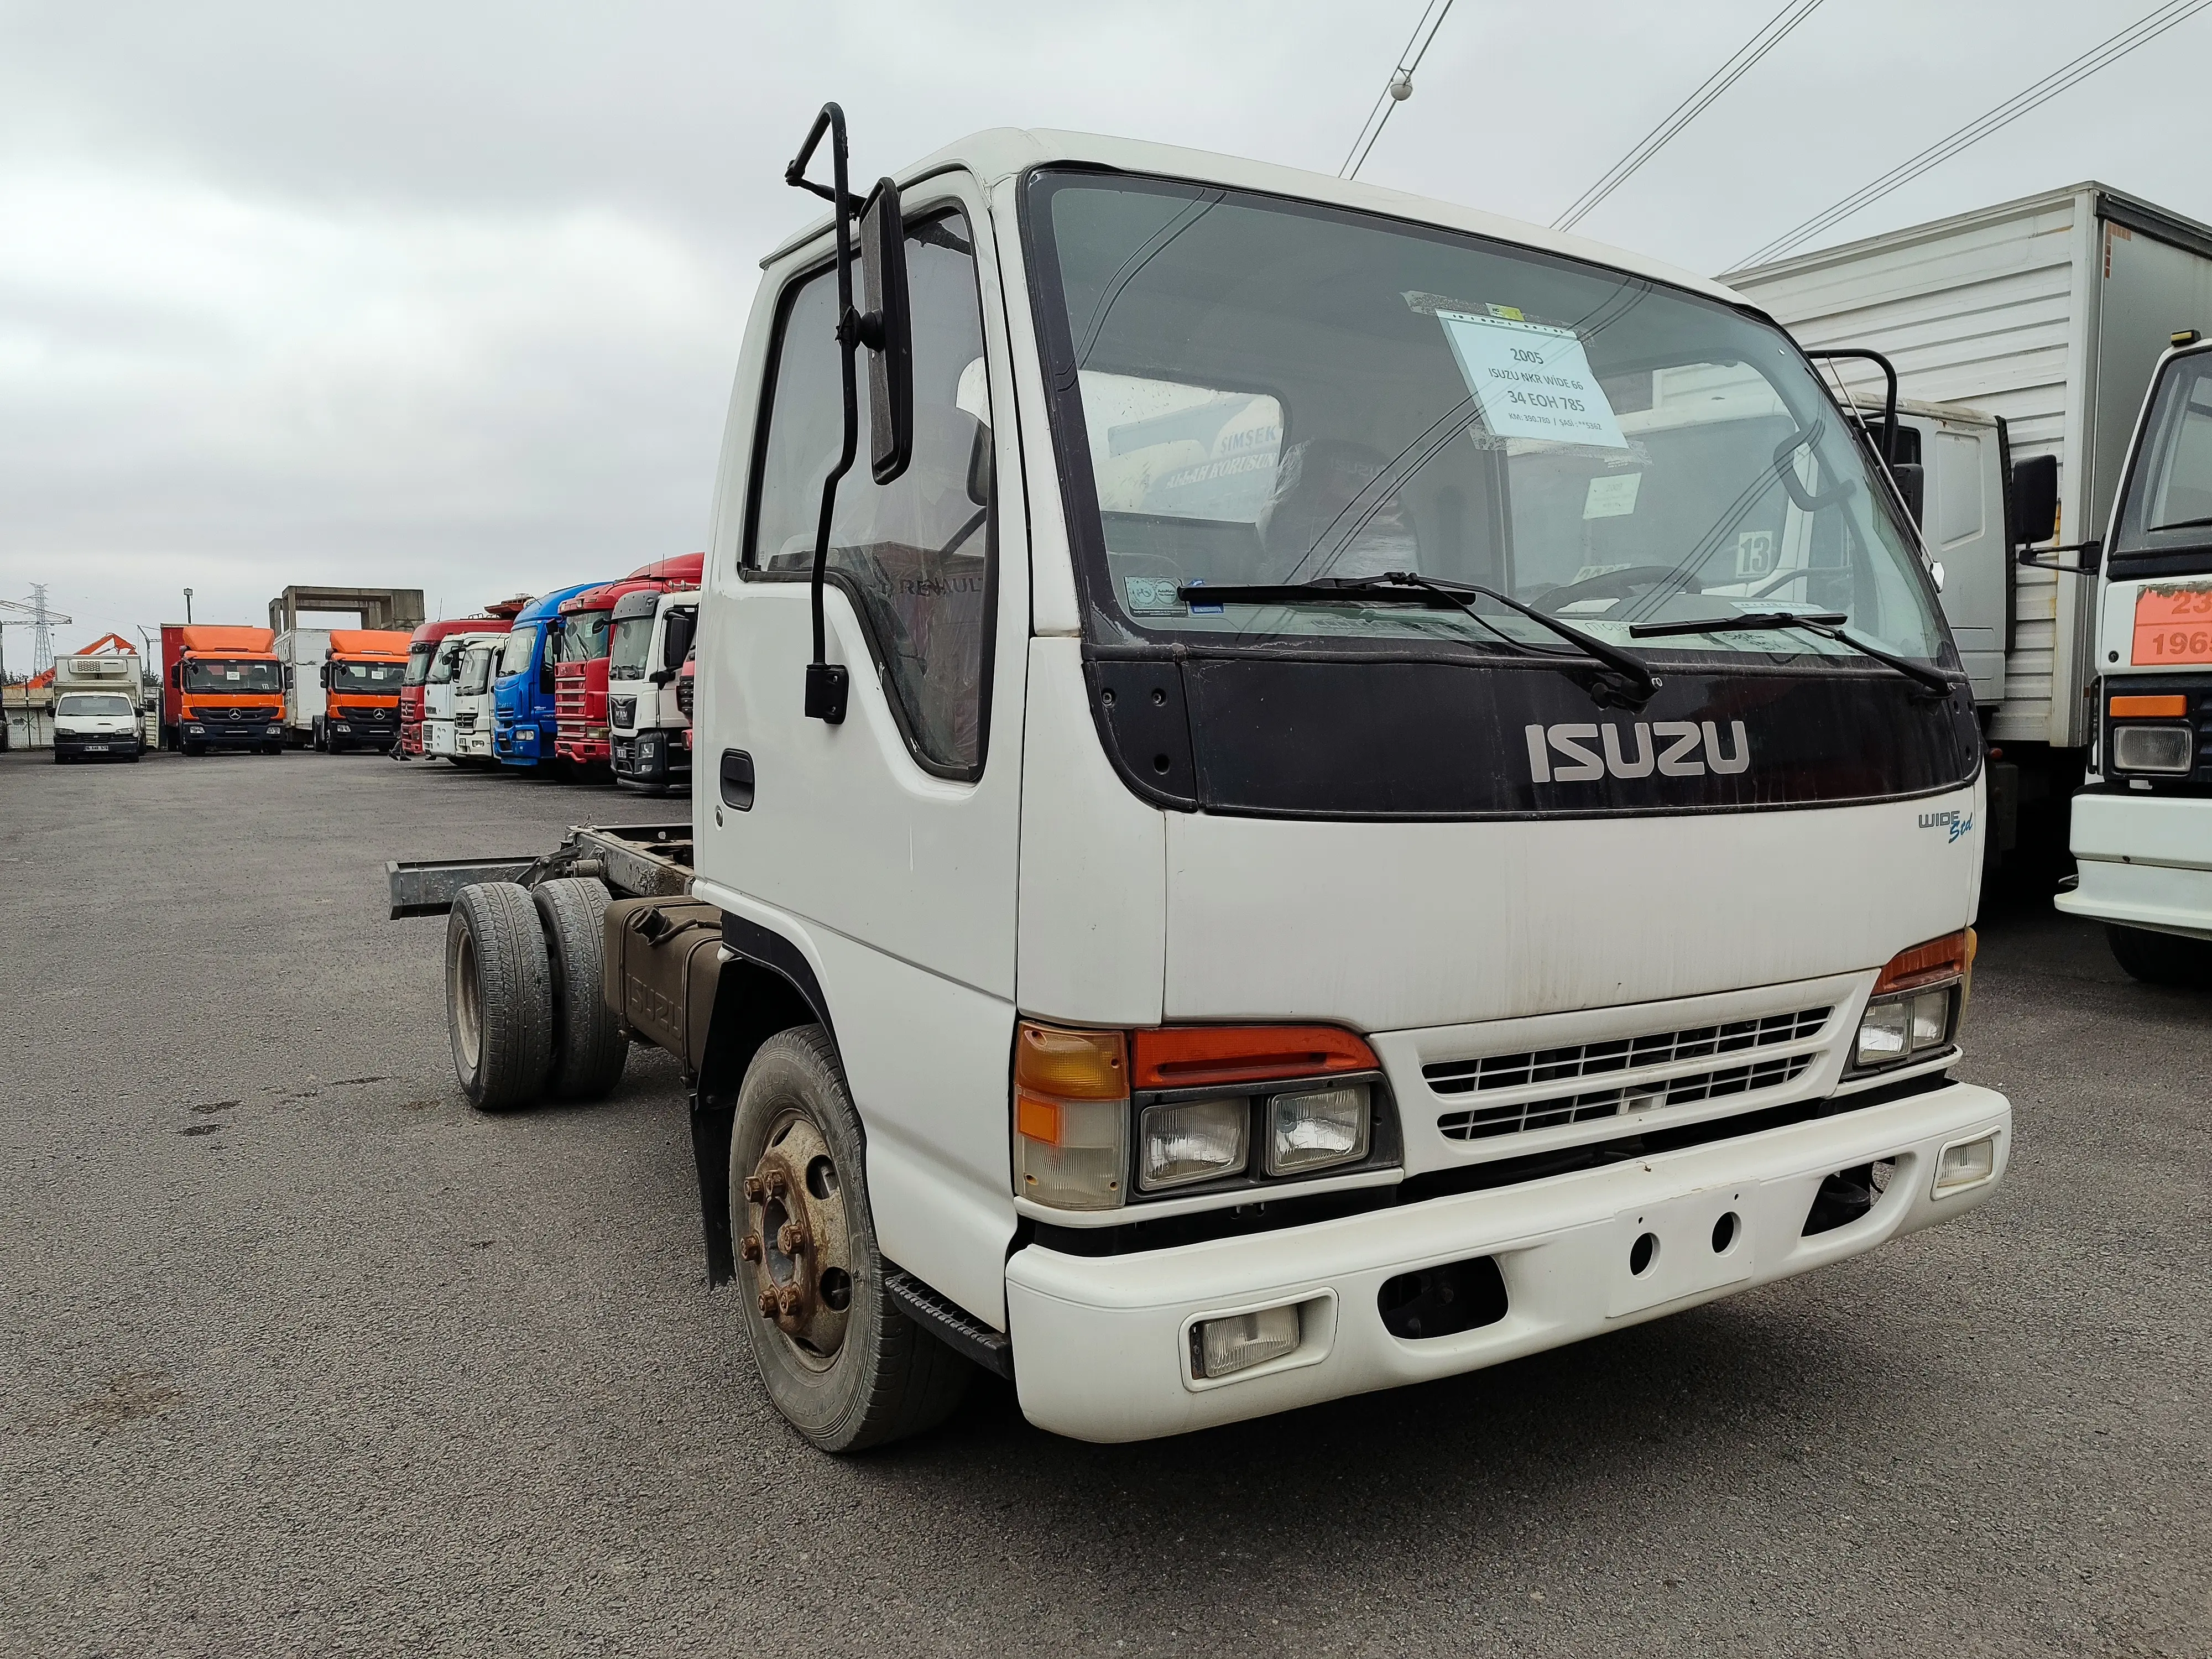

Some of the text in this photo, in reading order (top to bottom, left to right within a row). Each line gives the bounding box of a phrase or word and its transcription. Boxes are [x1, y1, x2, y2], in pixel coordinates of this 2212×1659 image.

[1510, 348, 1544, 364] 2005
[1488, 368, 1584, 390] ISUZU NKR WİDE 66
[1507, 390, 1585, 411] 34 EOH 785
[1208, 452, 1277, 479] KORUSUN
[1740, 536, 1770, 573] 13
[899, 577, 983, 597] RENAUL
[2153, 632, 2212, 655] 196
[1525, 721, 1750, 783] ISUZU
[1918, 810, 1960, 828] WIDE
